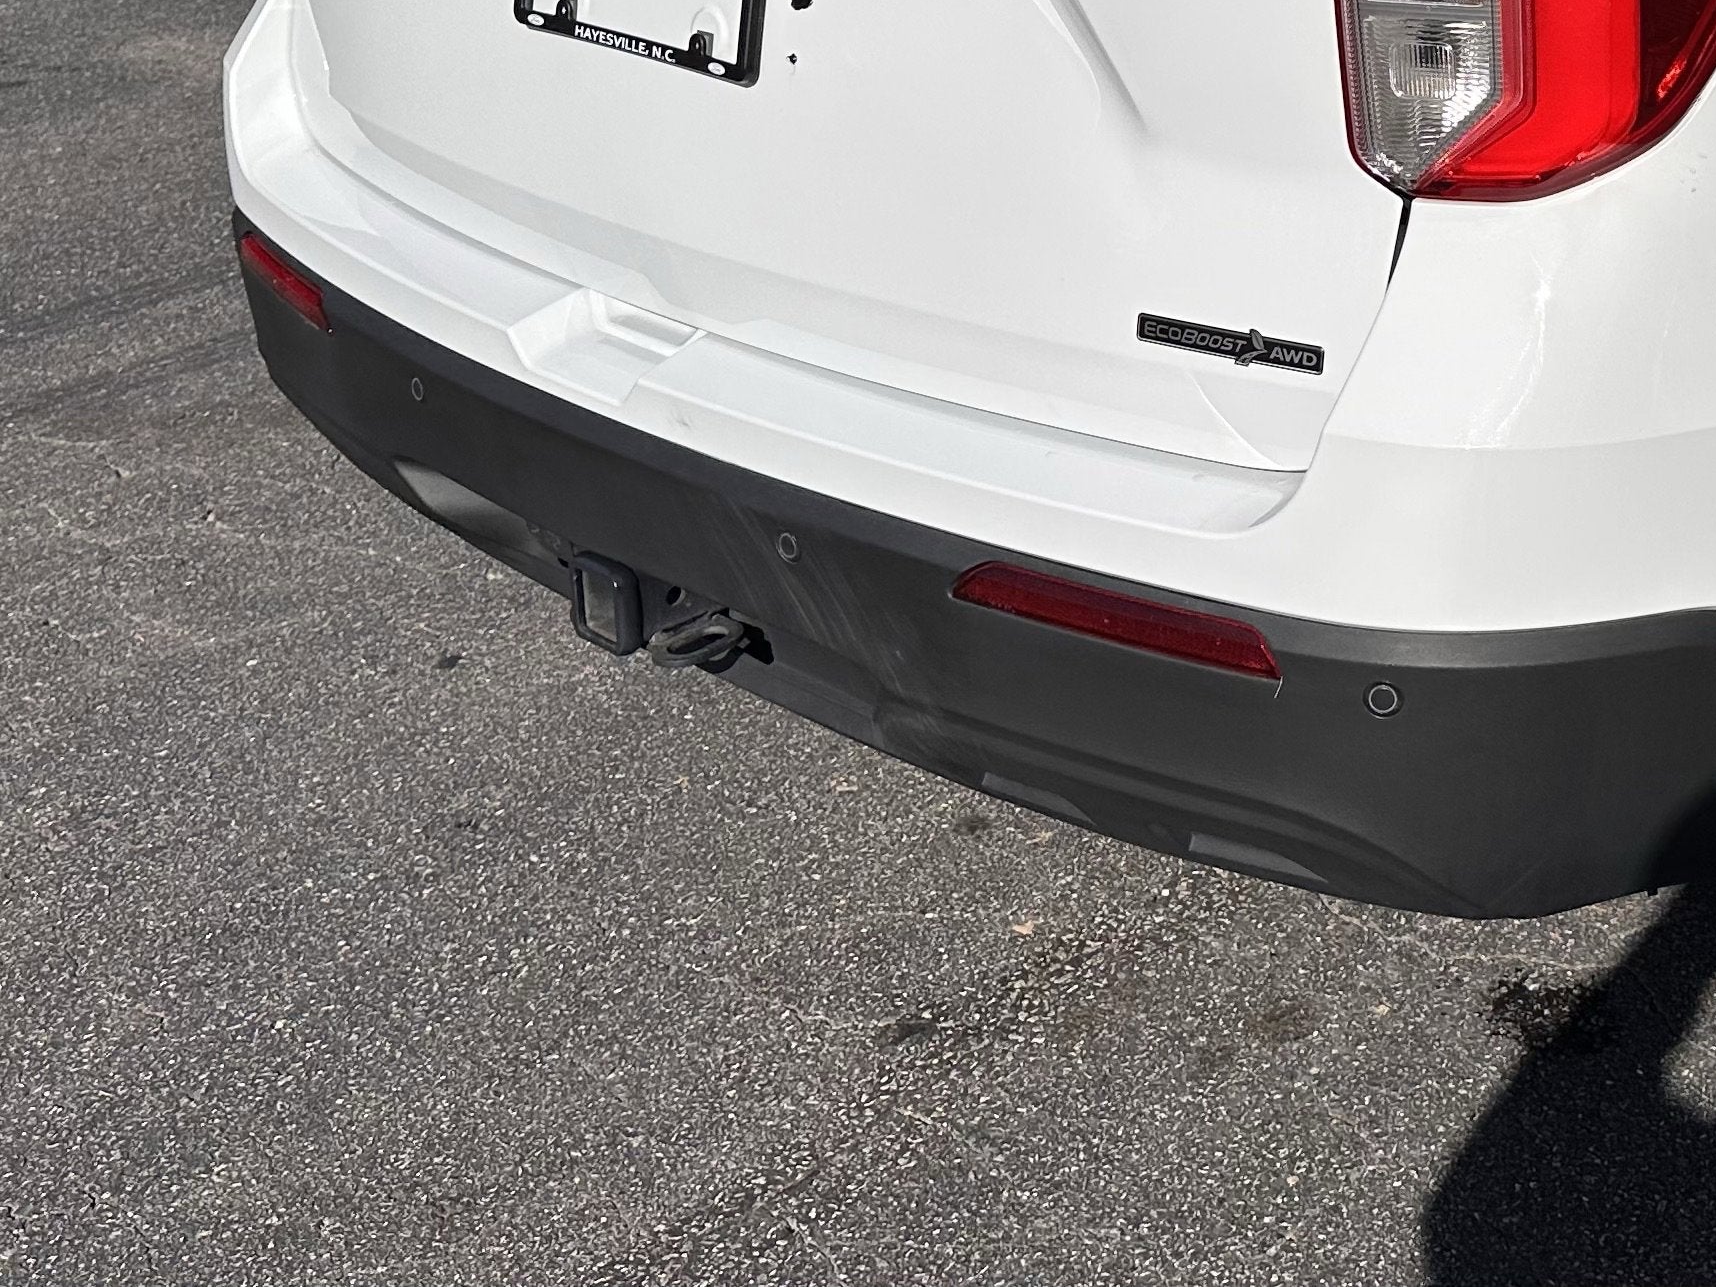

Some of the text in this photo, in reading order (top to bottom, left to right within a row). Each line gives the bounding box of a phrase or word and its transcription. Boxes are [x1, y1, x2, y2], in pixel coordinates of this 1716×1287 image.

[574, 24, 676, 64] HAYESVILLE, N.C.
[1268, 345, 1318, 367] AWD
